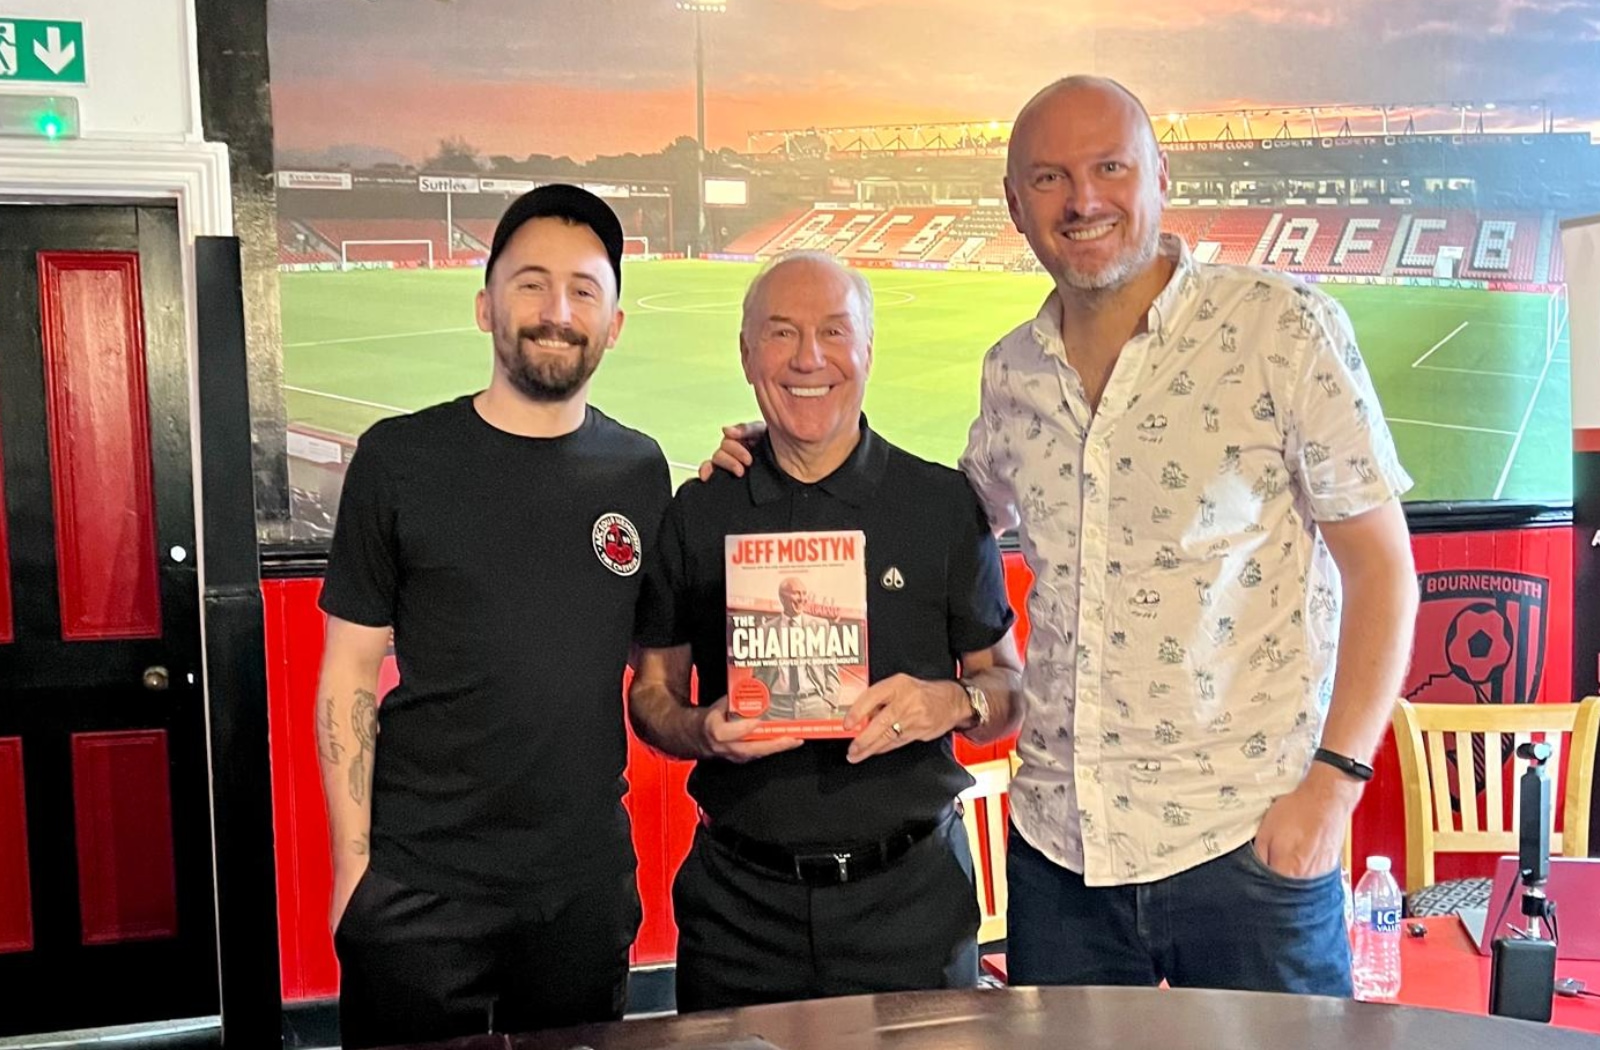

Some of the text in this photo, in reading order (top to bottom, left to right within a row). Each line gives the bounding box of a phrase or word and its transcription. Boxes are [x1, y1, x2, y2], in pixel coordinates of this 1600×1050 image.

[1225, 141, 1254, 150] CLOUD
[421, 178, 467, 191] Suttles
[1268, 217, 1517, 269] AFCB
[732, 537, 855, 564] JEFF MOSTYN
[1427, 574, 1542, 599] BOURNEMOUTH
[733, 616, 754, 627] THE
[732, 625, 859, 660] CHAIRMAN
[1377, 910, 1401, 925] ICE
